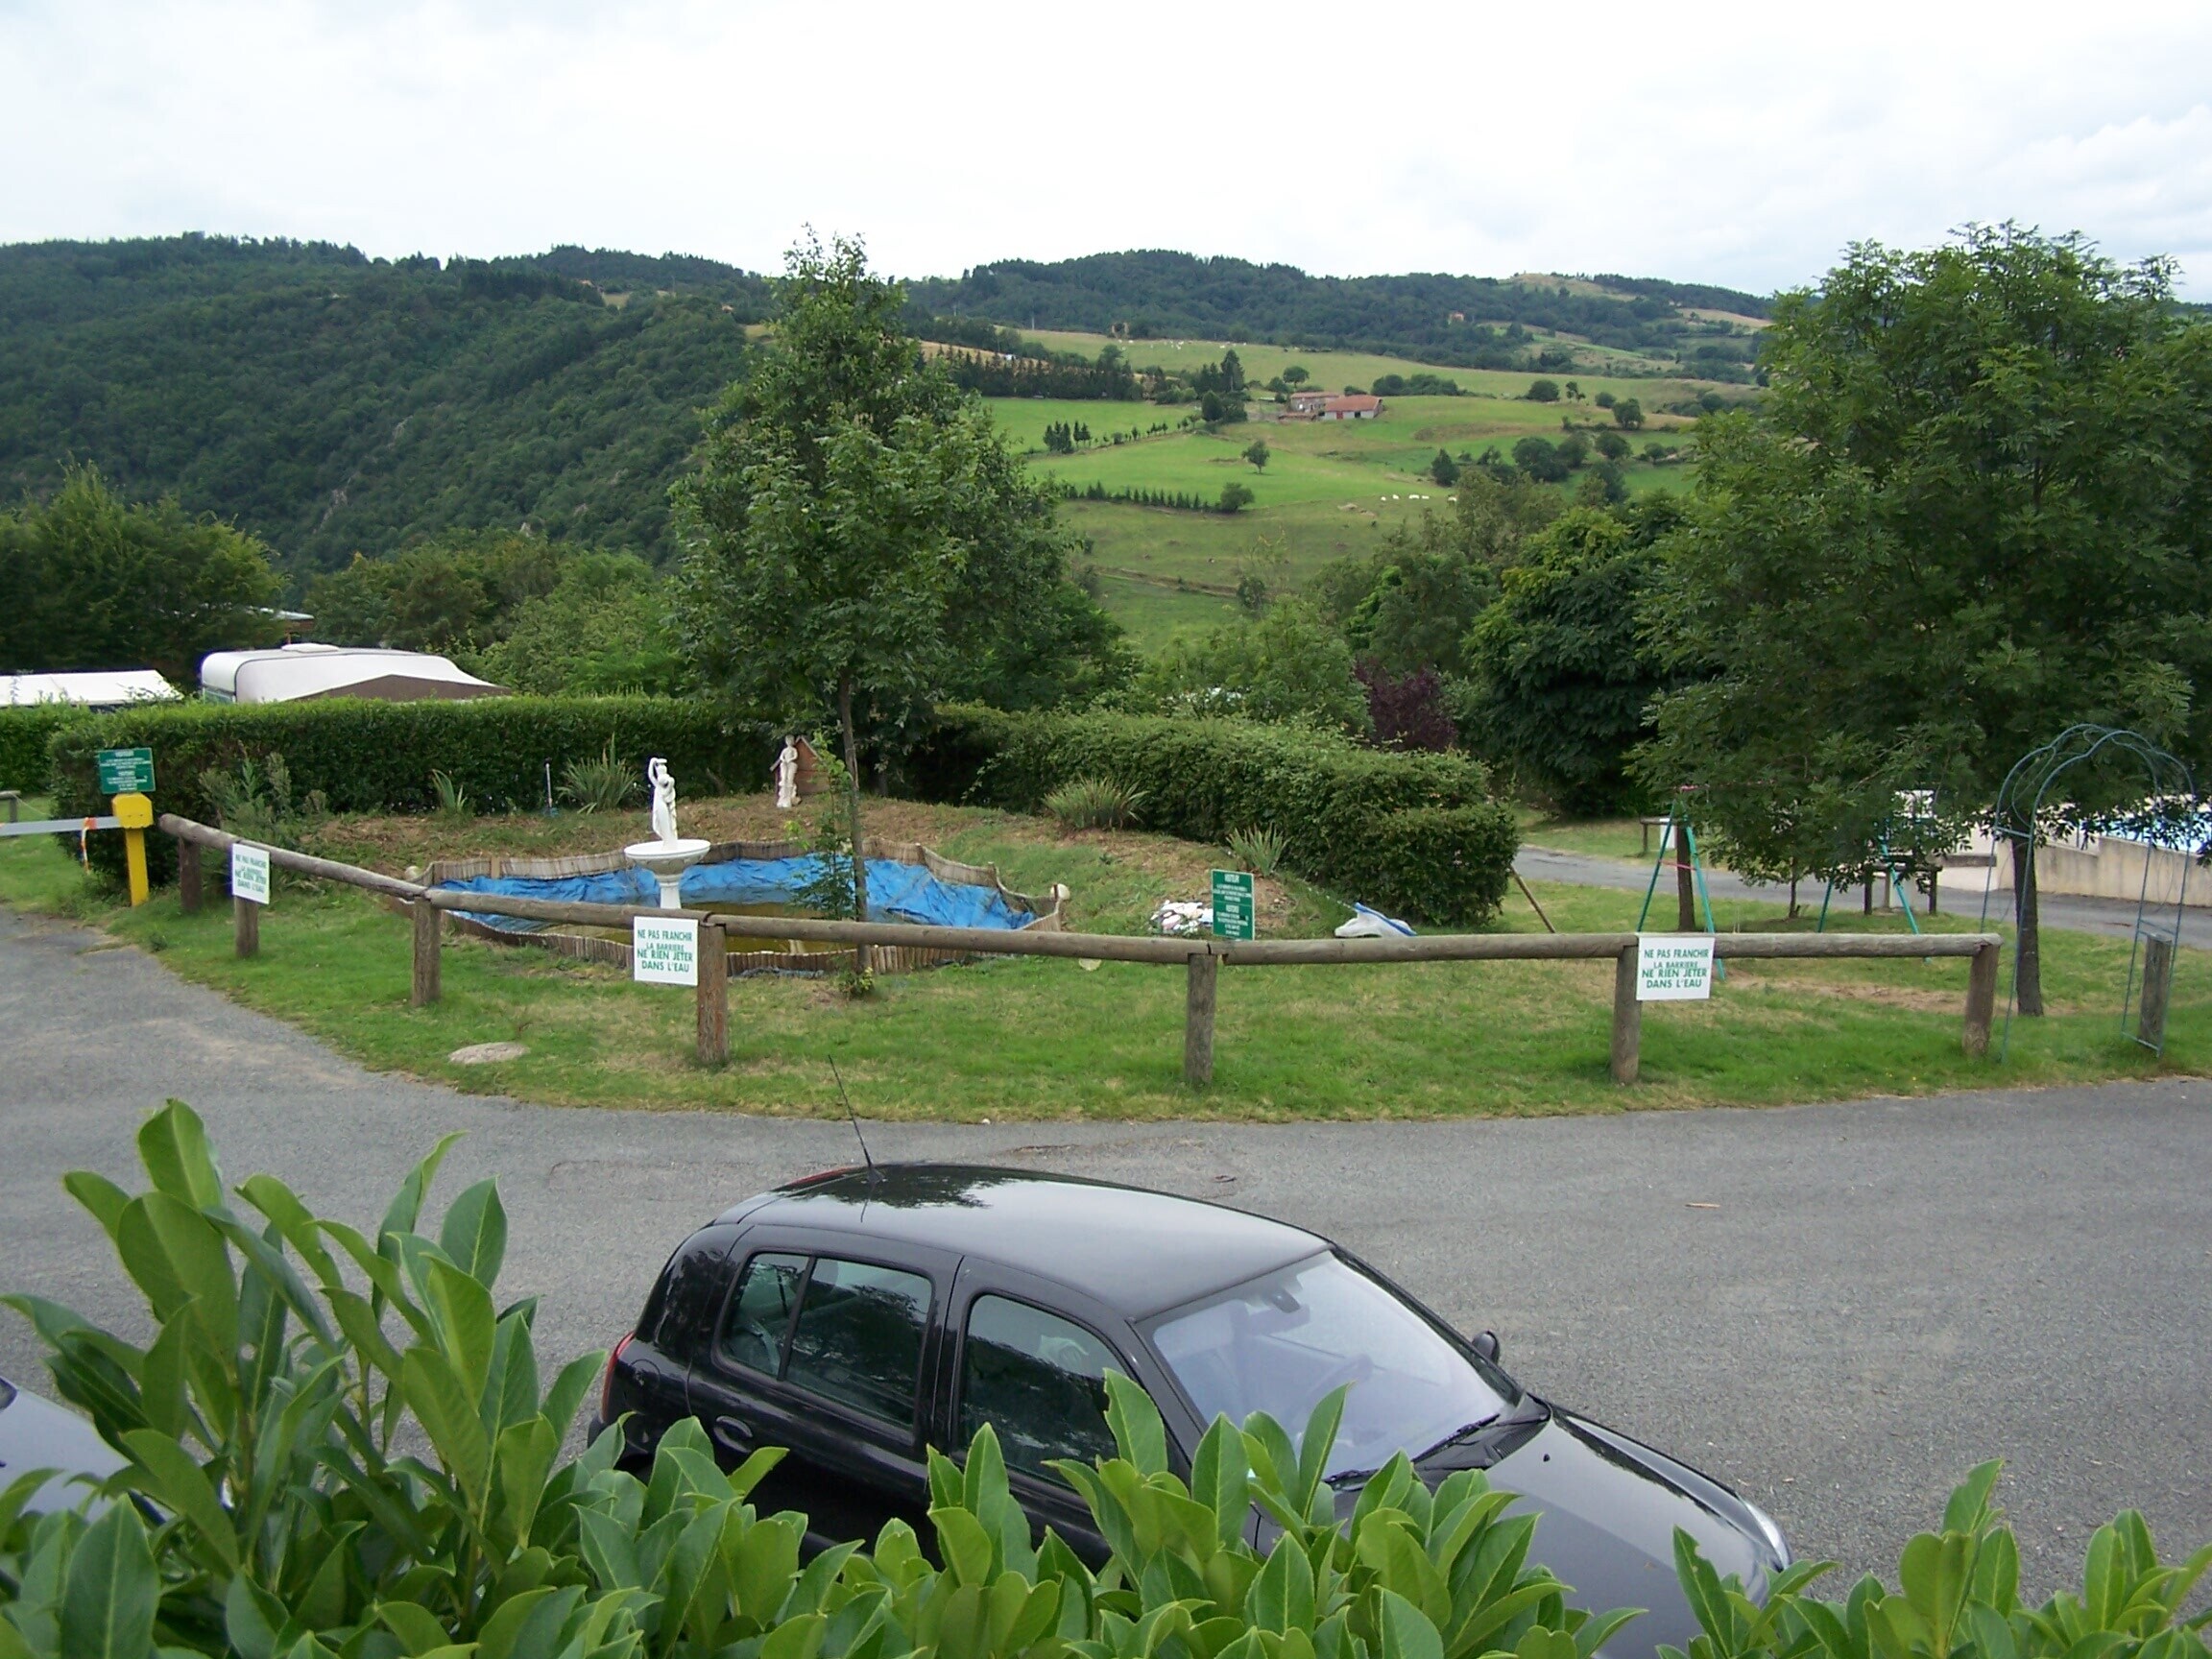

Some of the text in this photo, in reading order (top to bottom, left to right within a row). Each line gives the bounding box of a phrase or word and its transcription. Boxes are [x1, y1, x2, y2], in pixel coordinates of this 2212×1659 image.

[637, 929, 692, 941] NE PAS FRANCHIR
[637, 949, 693, 962] NE RIEN JETER
[1644, 949, 1709, 958] NE PAS FRANCHIR
[641, 960, 690, 973] DANS L'EAU
[1642, 968, 1707, 977] NE RIEN JETER
[1647, 978, 1702, 988] DANS L'EAU
